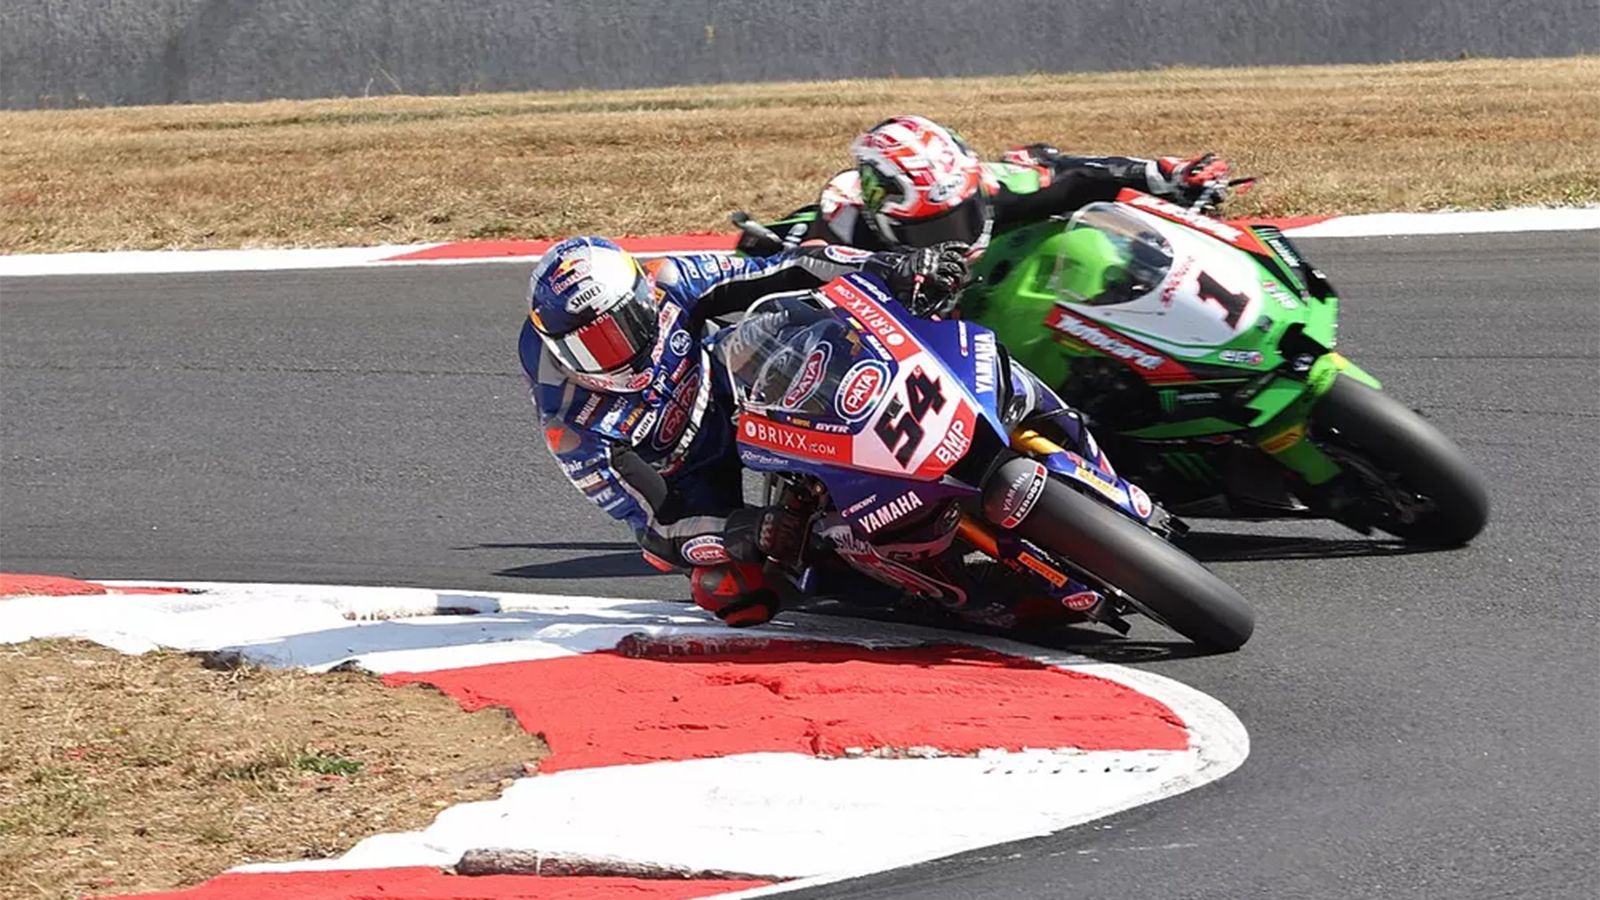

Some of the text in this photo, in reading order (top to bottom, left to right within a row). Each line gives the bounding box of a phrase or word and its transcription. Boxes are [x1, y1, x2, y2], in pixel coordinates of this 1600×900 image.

[570, 285, 602, 309] SHOEI
[1196, 269, 1251, 331] 1
[786, 360, 820, 403] PATA
[974, 333, 996, 394] YAMAHA
[846, 371, 878, 409] PATA
[633, 411, 655, 442] SHOEI
[815, 422, 850, 434] GYTR
[873, 363, 947, 469] 54
[935, 419, 966, 464] BMP
[858, 490, 924, 535] YAMAHA
[1003, 471, 1031, 513] YAMAHA
[1016, 478, 1042, 519] FERODO
